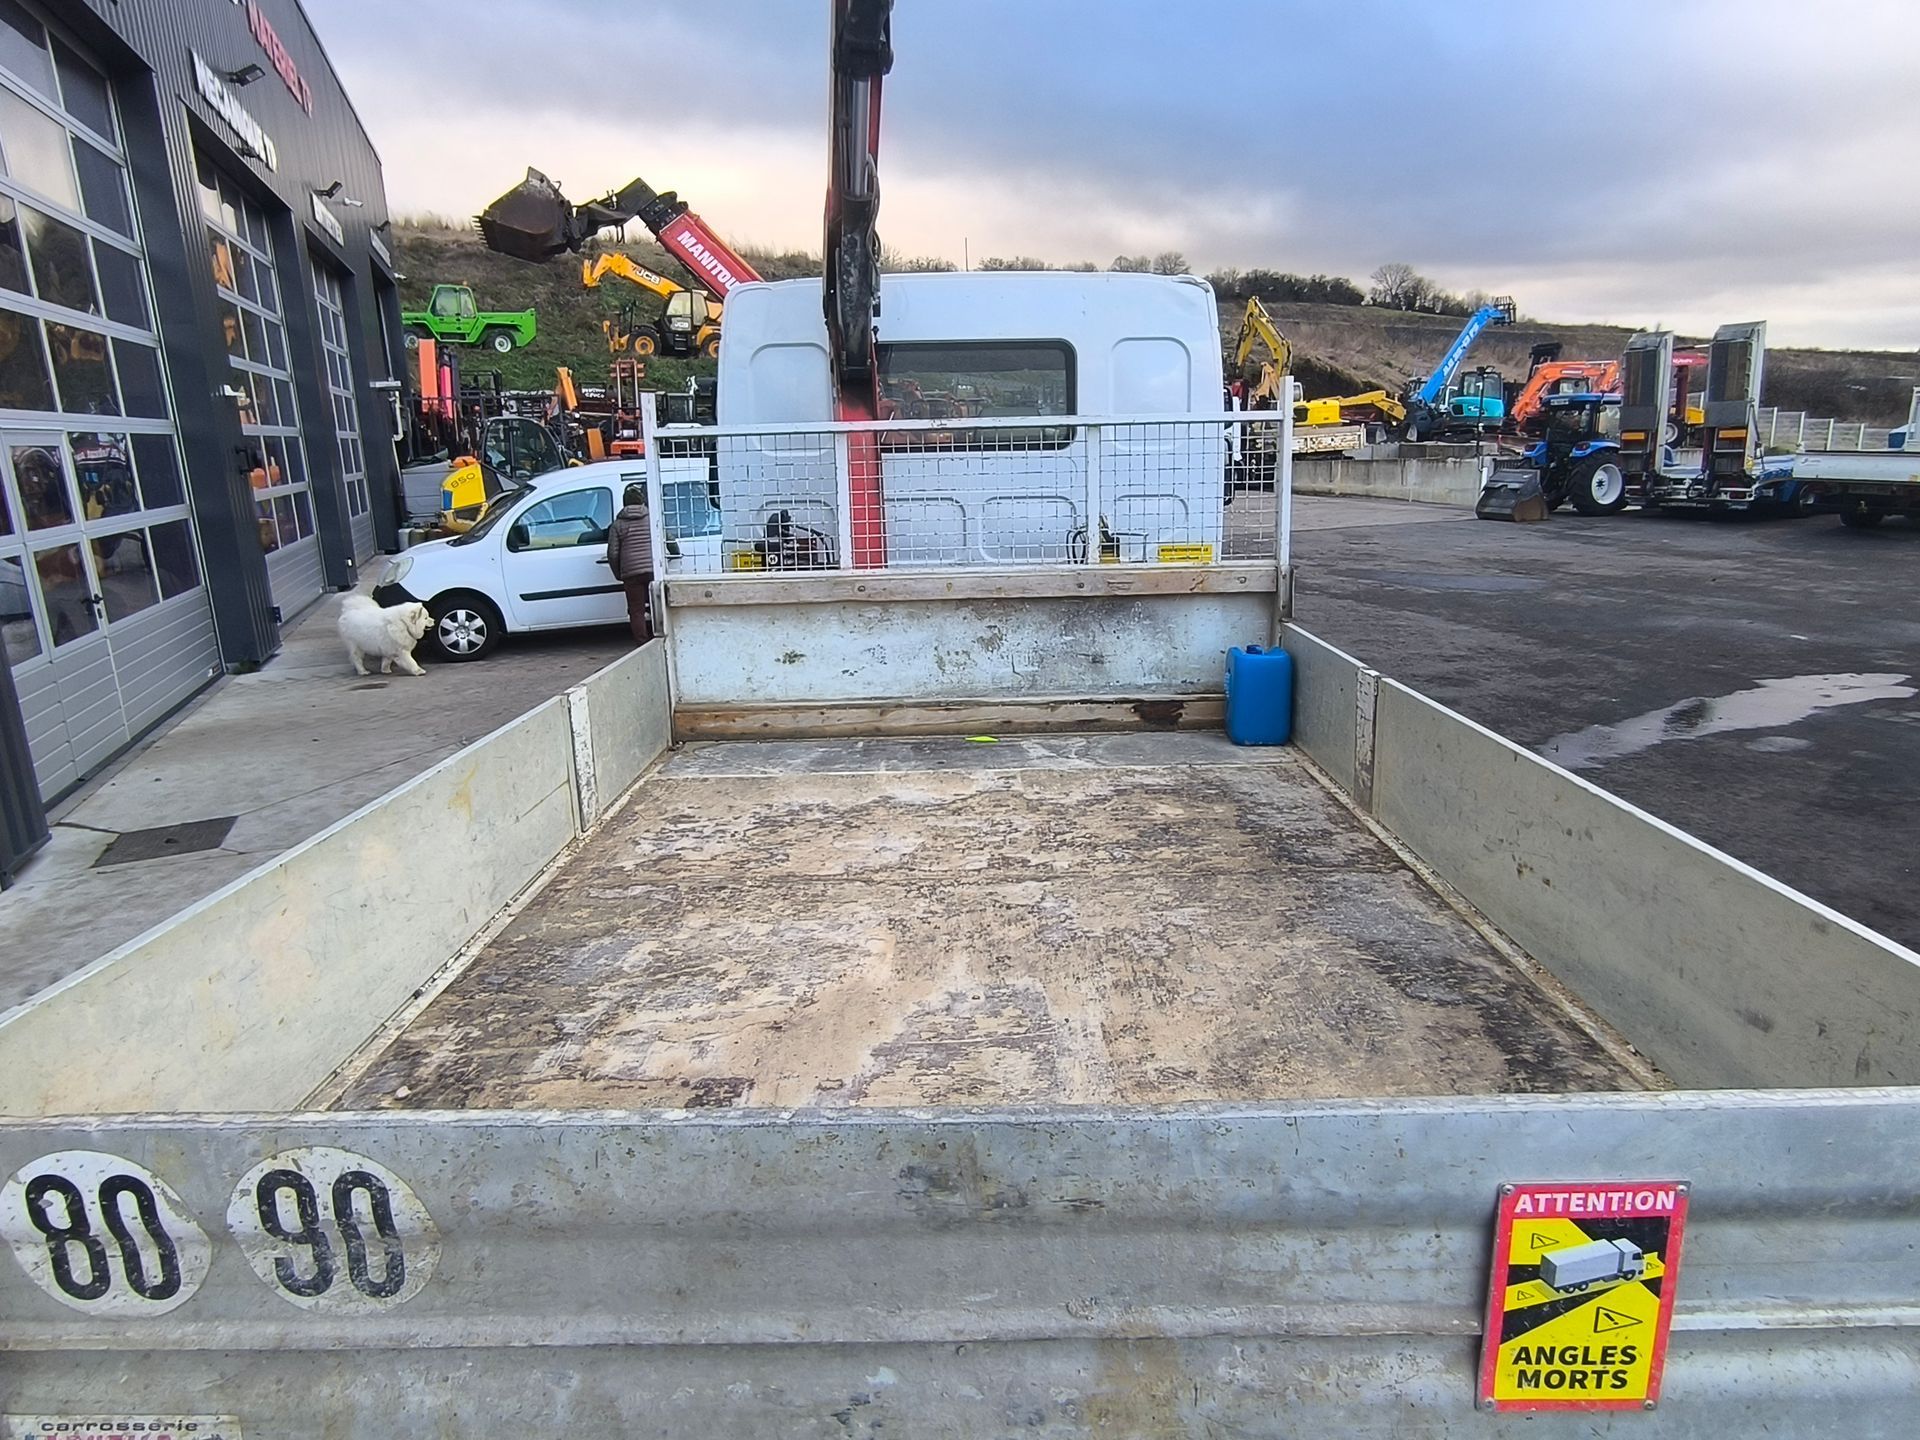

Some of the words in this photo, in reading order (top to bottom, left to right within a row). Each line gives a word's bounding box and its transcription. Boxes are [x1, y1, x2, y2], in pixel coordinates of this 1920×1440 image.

[677, 230, 741, 290] MANITOU
[636, 268, 660, 284] JCB
[1513, 1190, 1676, 1214] ATTENTION
[25, 1173, 182, 1301] 80
[256, 1168, 406, 1298] 90
[1511, 1345, 1638, 1366] ANGLES
[1516, 1369, 1628, 1390] MORTS
[41, 1419, 199, 1432] carrosserie
